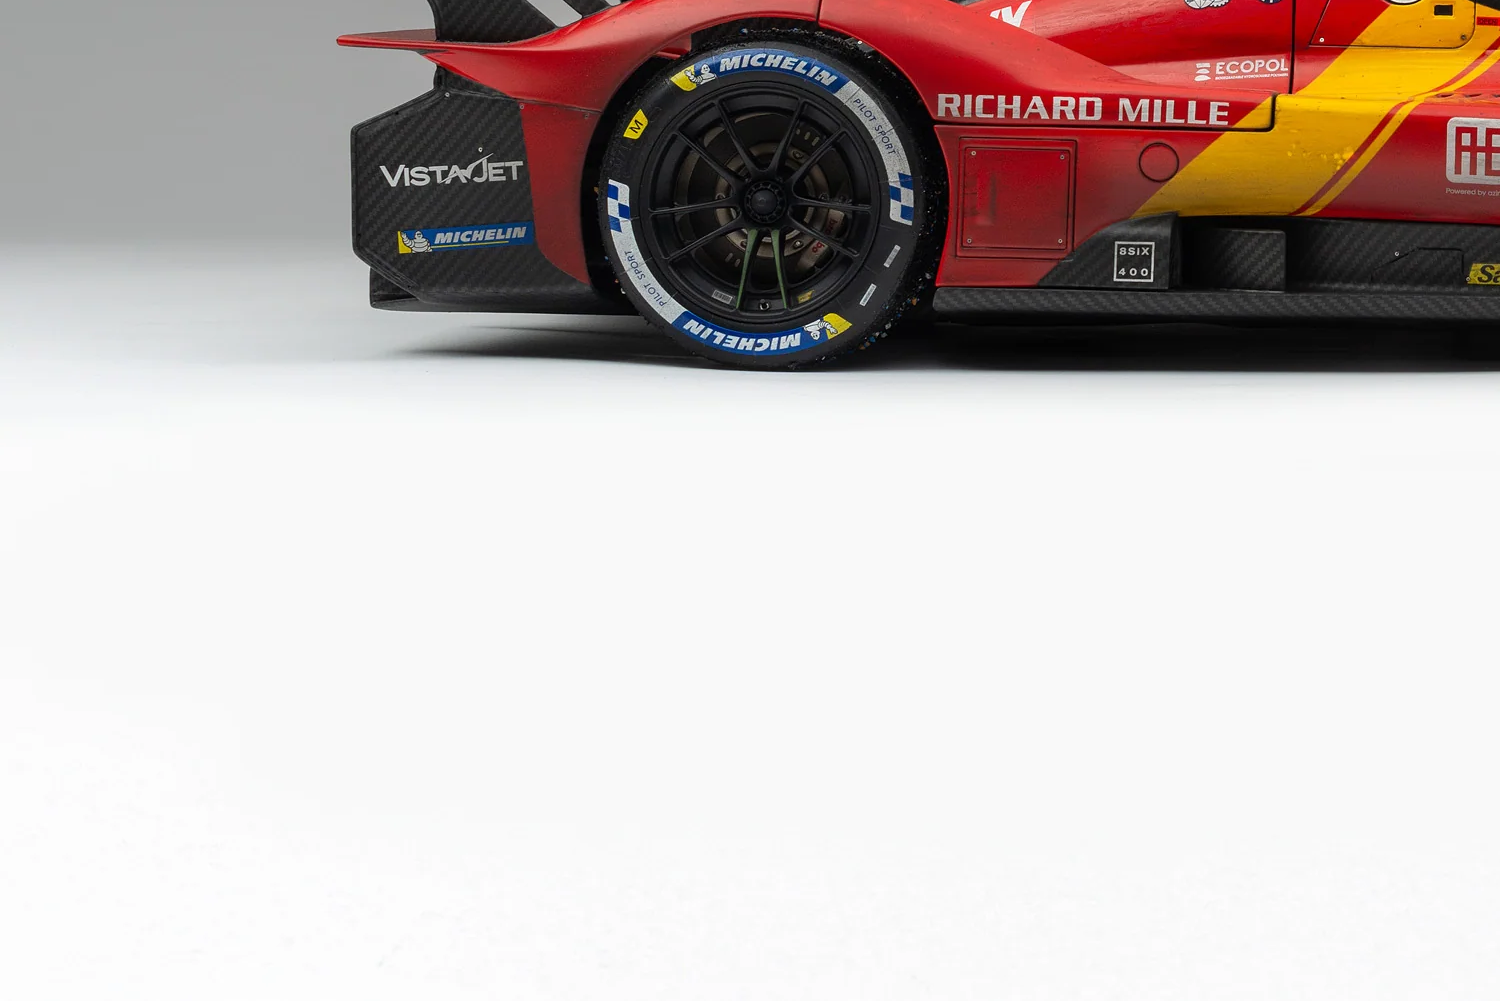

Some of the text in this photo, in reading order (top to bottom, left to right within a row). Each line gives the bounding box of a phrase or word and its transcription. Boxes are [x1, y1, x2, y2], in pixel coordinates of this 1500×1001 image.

[719, 52, 838, 87] MICHELIN
[1215, 58, 1289, 75] ECOPOL
[937, 93, 1230, 126] RICHARD MILLE
[630, 119, 644, 134] M
[853, 98, 896, 156] PILOT SPORT
[1445, 187, 1476, 195] Powered
[1477, 189, 1486, 197] by
[433, 226, 527, 245] MICHELIN
[1119, 246, 1150, 256] 8SIX
[624, 250, 667, 308] PILOT SPORT
[682, 318, 801, 353] MICHELIN
